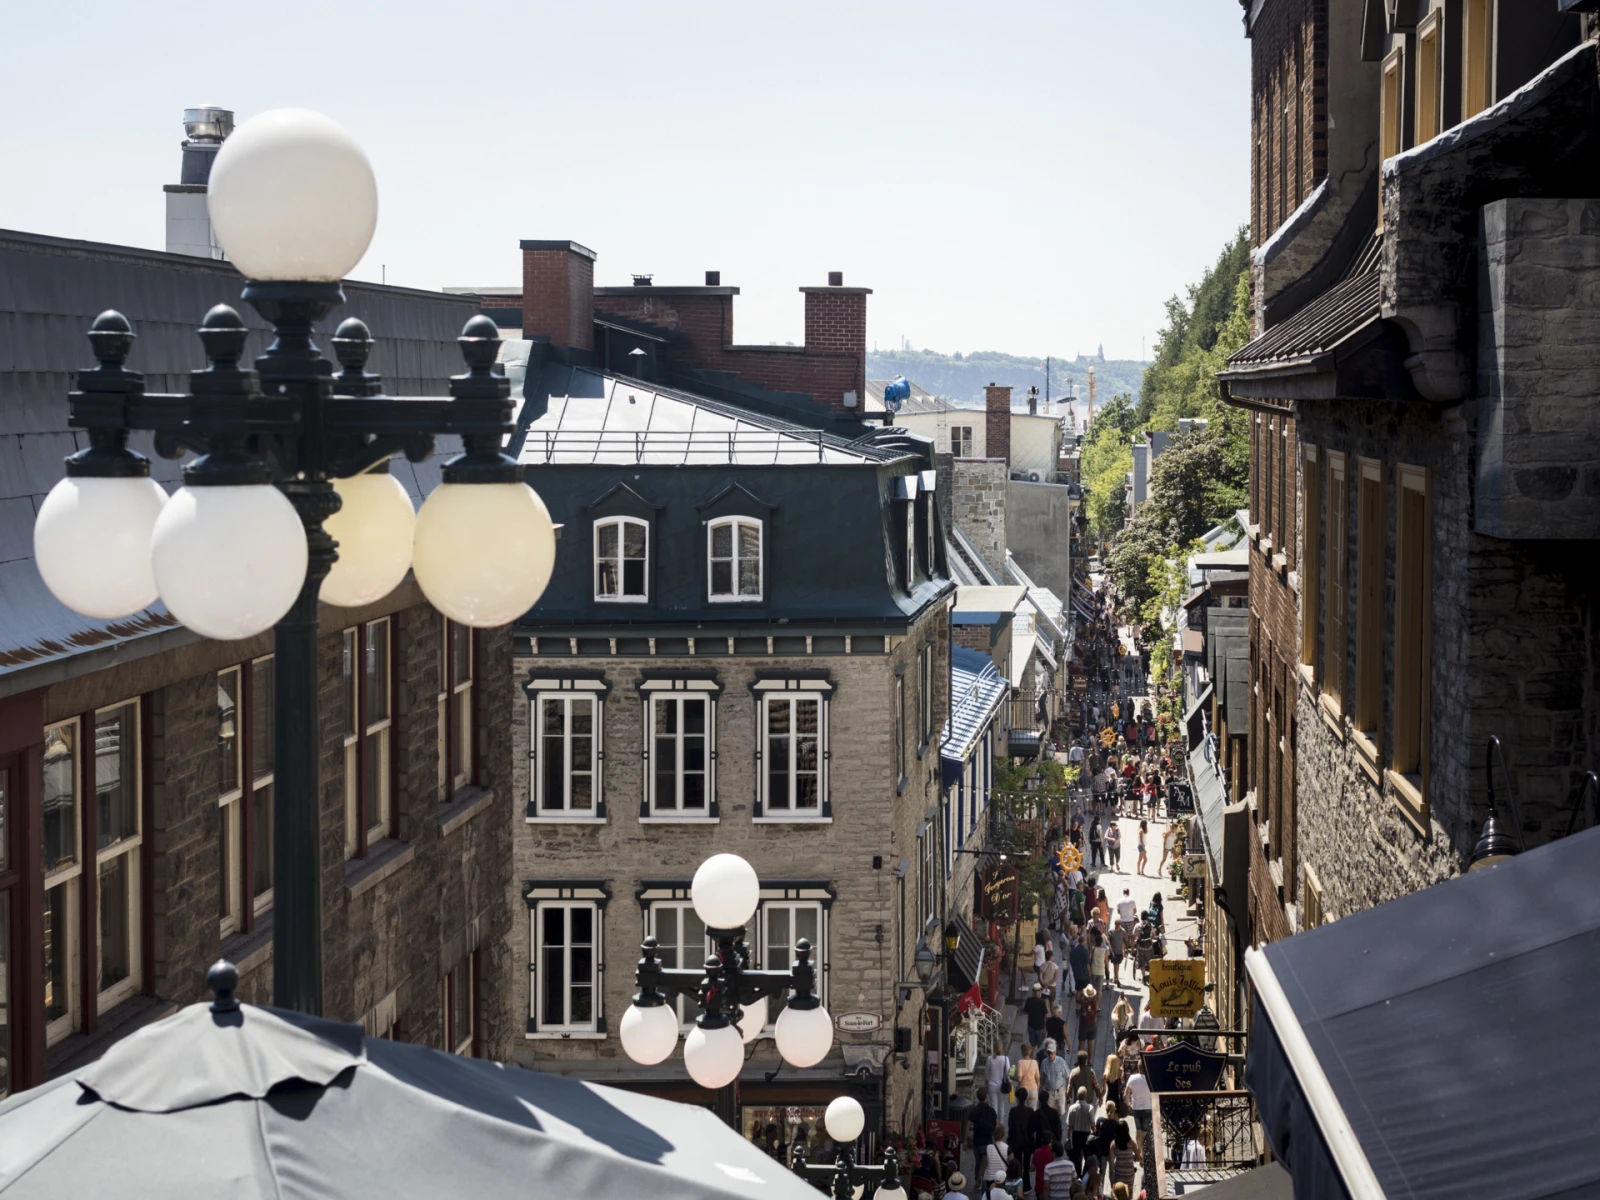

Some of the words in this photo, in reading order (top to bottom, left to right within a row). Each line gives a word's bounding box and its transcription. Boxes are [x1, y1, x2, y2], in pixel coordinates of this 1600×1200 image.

[1161, 962, 1193, 973] boutique
[1151, 976, 1177, 994] Louis
[1166, 1061, 1180, 1072] Le
[1182, 1060, 1202, 1074] pub
[1175, 1075, 1192, 1089] des
